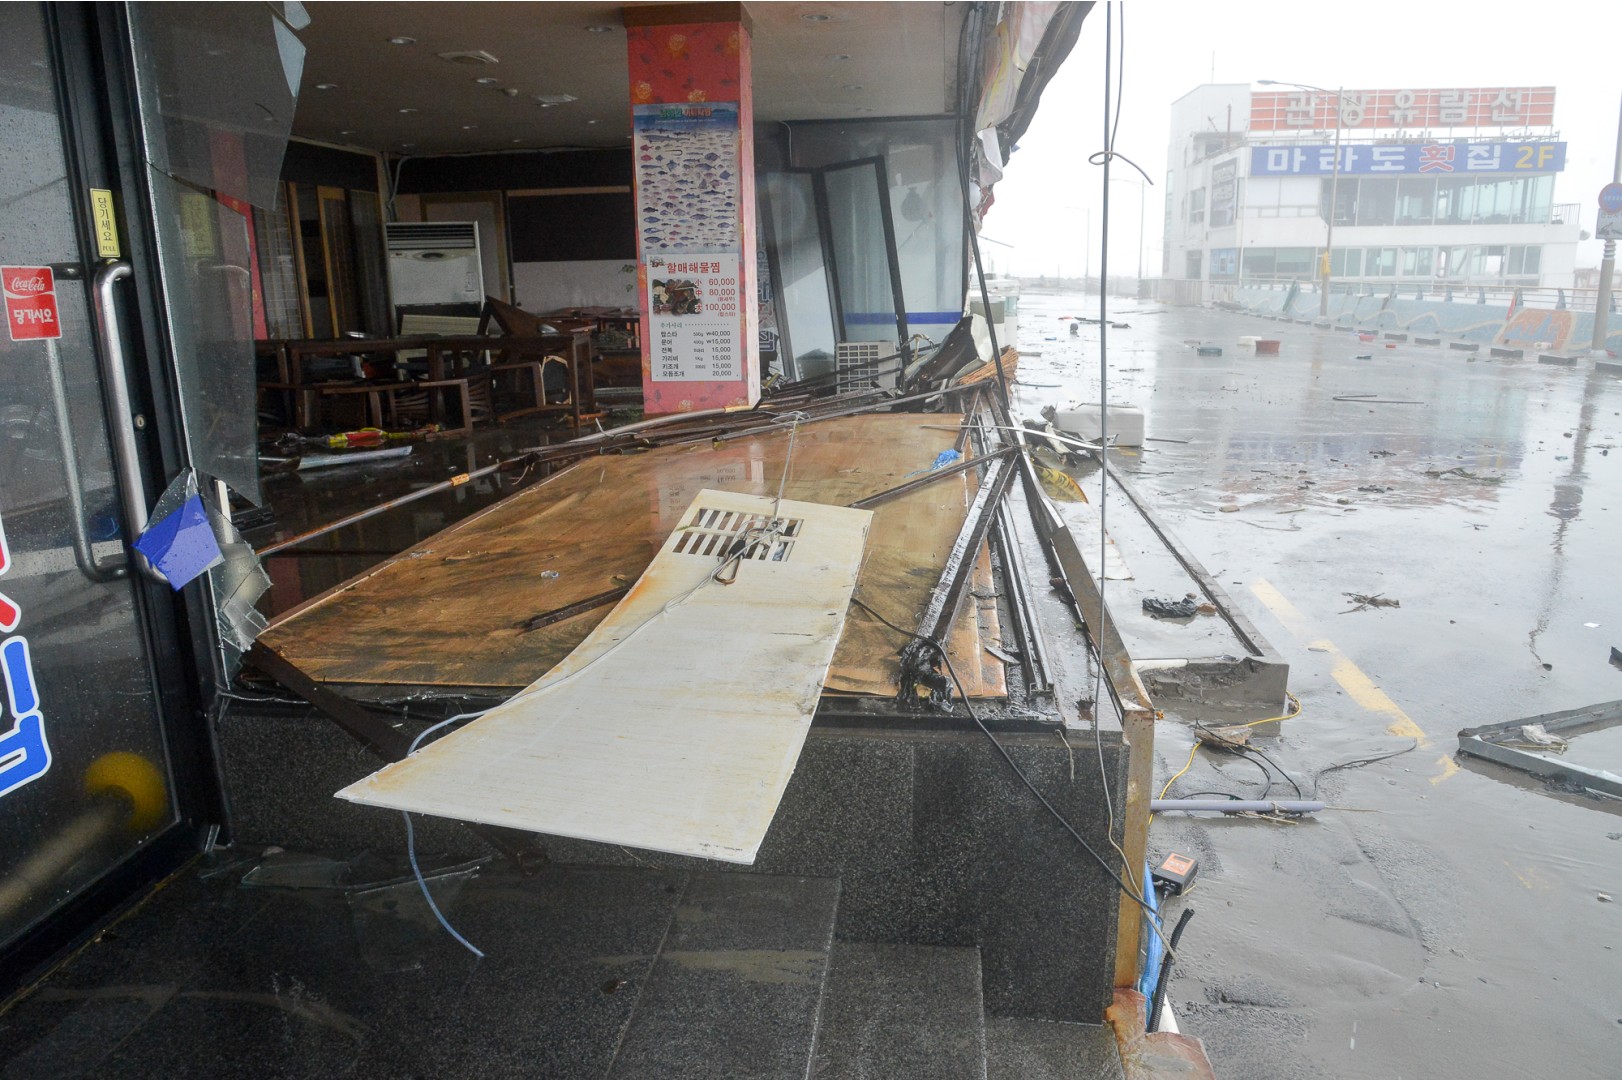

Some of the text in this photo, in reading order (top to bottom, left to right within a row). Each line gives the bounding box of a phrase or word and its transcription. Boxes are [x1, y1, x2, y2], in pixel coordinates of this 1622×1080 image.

[1515, 146, 1555, 170] 2F
[98, 197, 113, 241] 당기세요
[667, 262, 720, 274] 할매해물찜
[708, 278, 735, 287] 60,000
[709, 289, 736, 297] 80,000
[705, 303, 736, 312] 100,000
[13, 308, 54, 325] 당기시오
